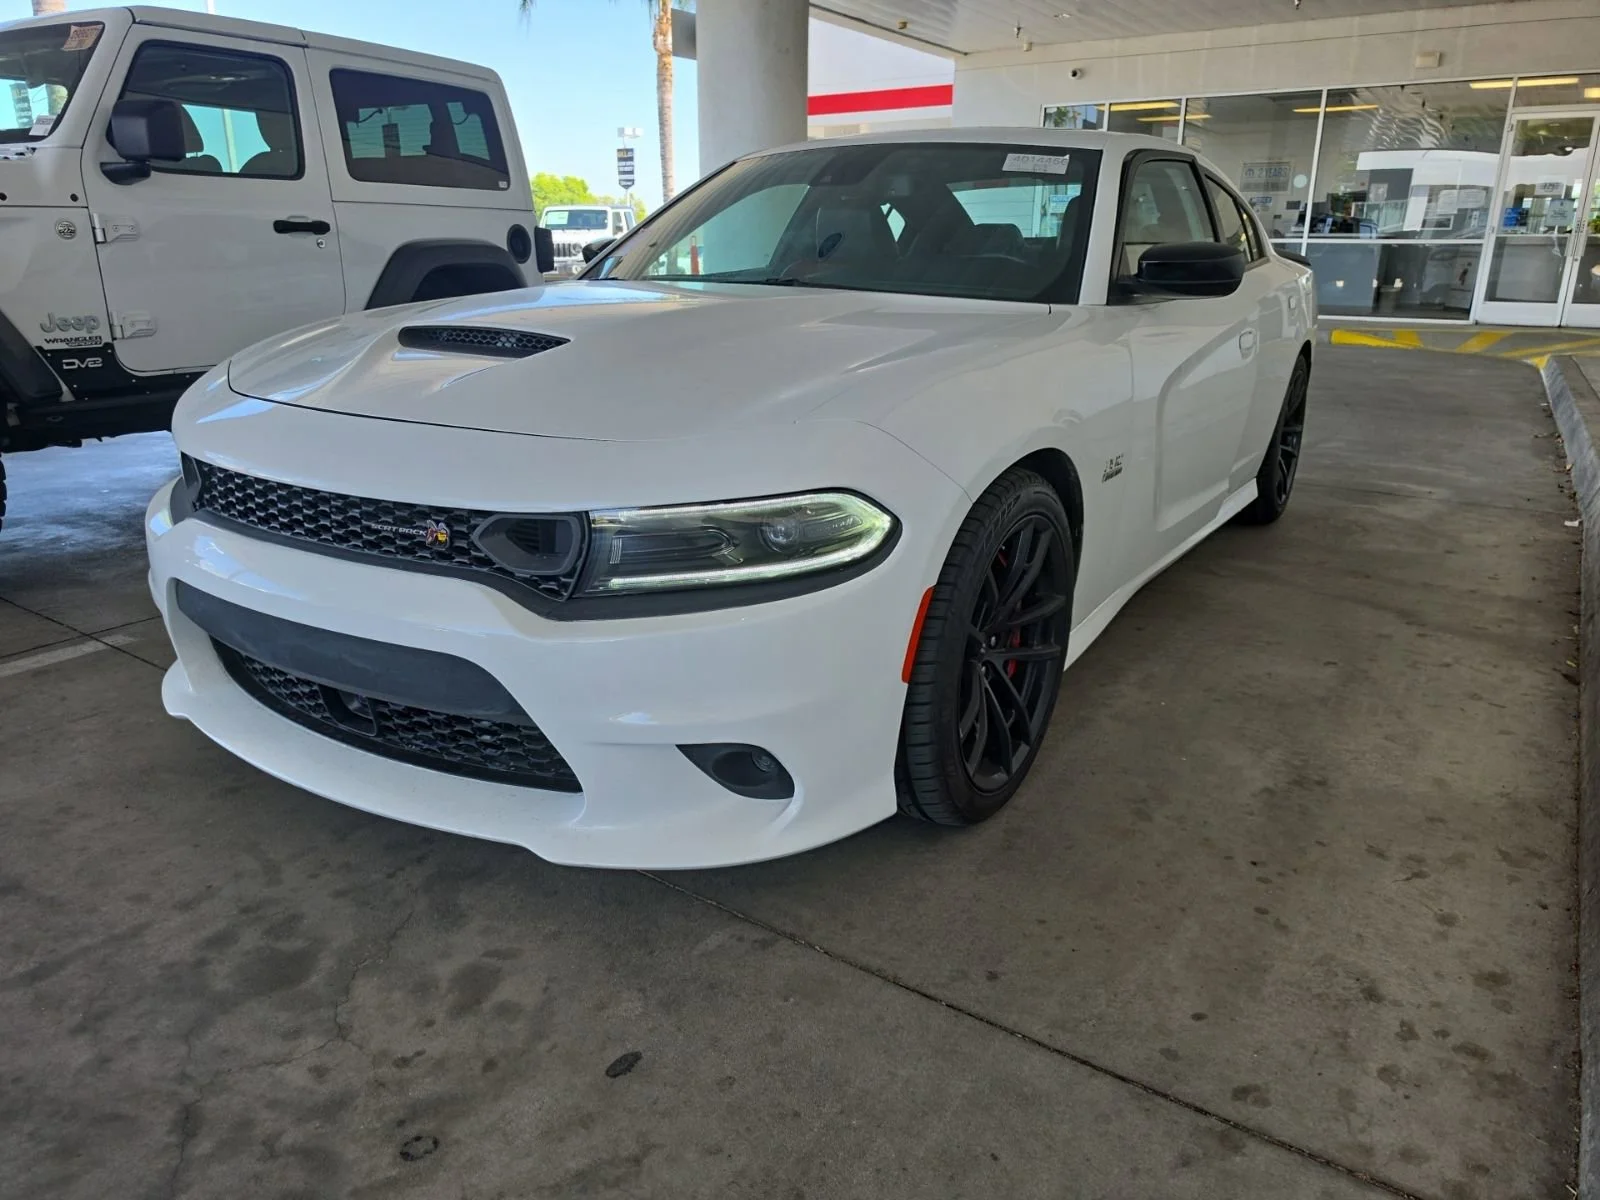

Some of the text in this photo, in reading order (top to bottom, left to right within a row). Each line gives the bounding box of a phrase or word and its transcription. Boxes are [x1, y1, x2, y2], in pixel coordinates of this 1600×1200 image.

[40, 312, 100, 333] Jeep
[44, 335, 102, 345] WRANGLER
[371, 523, 427, 537] SCAT PACK
